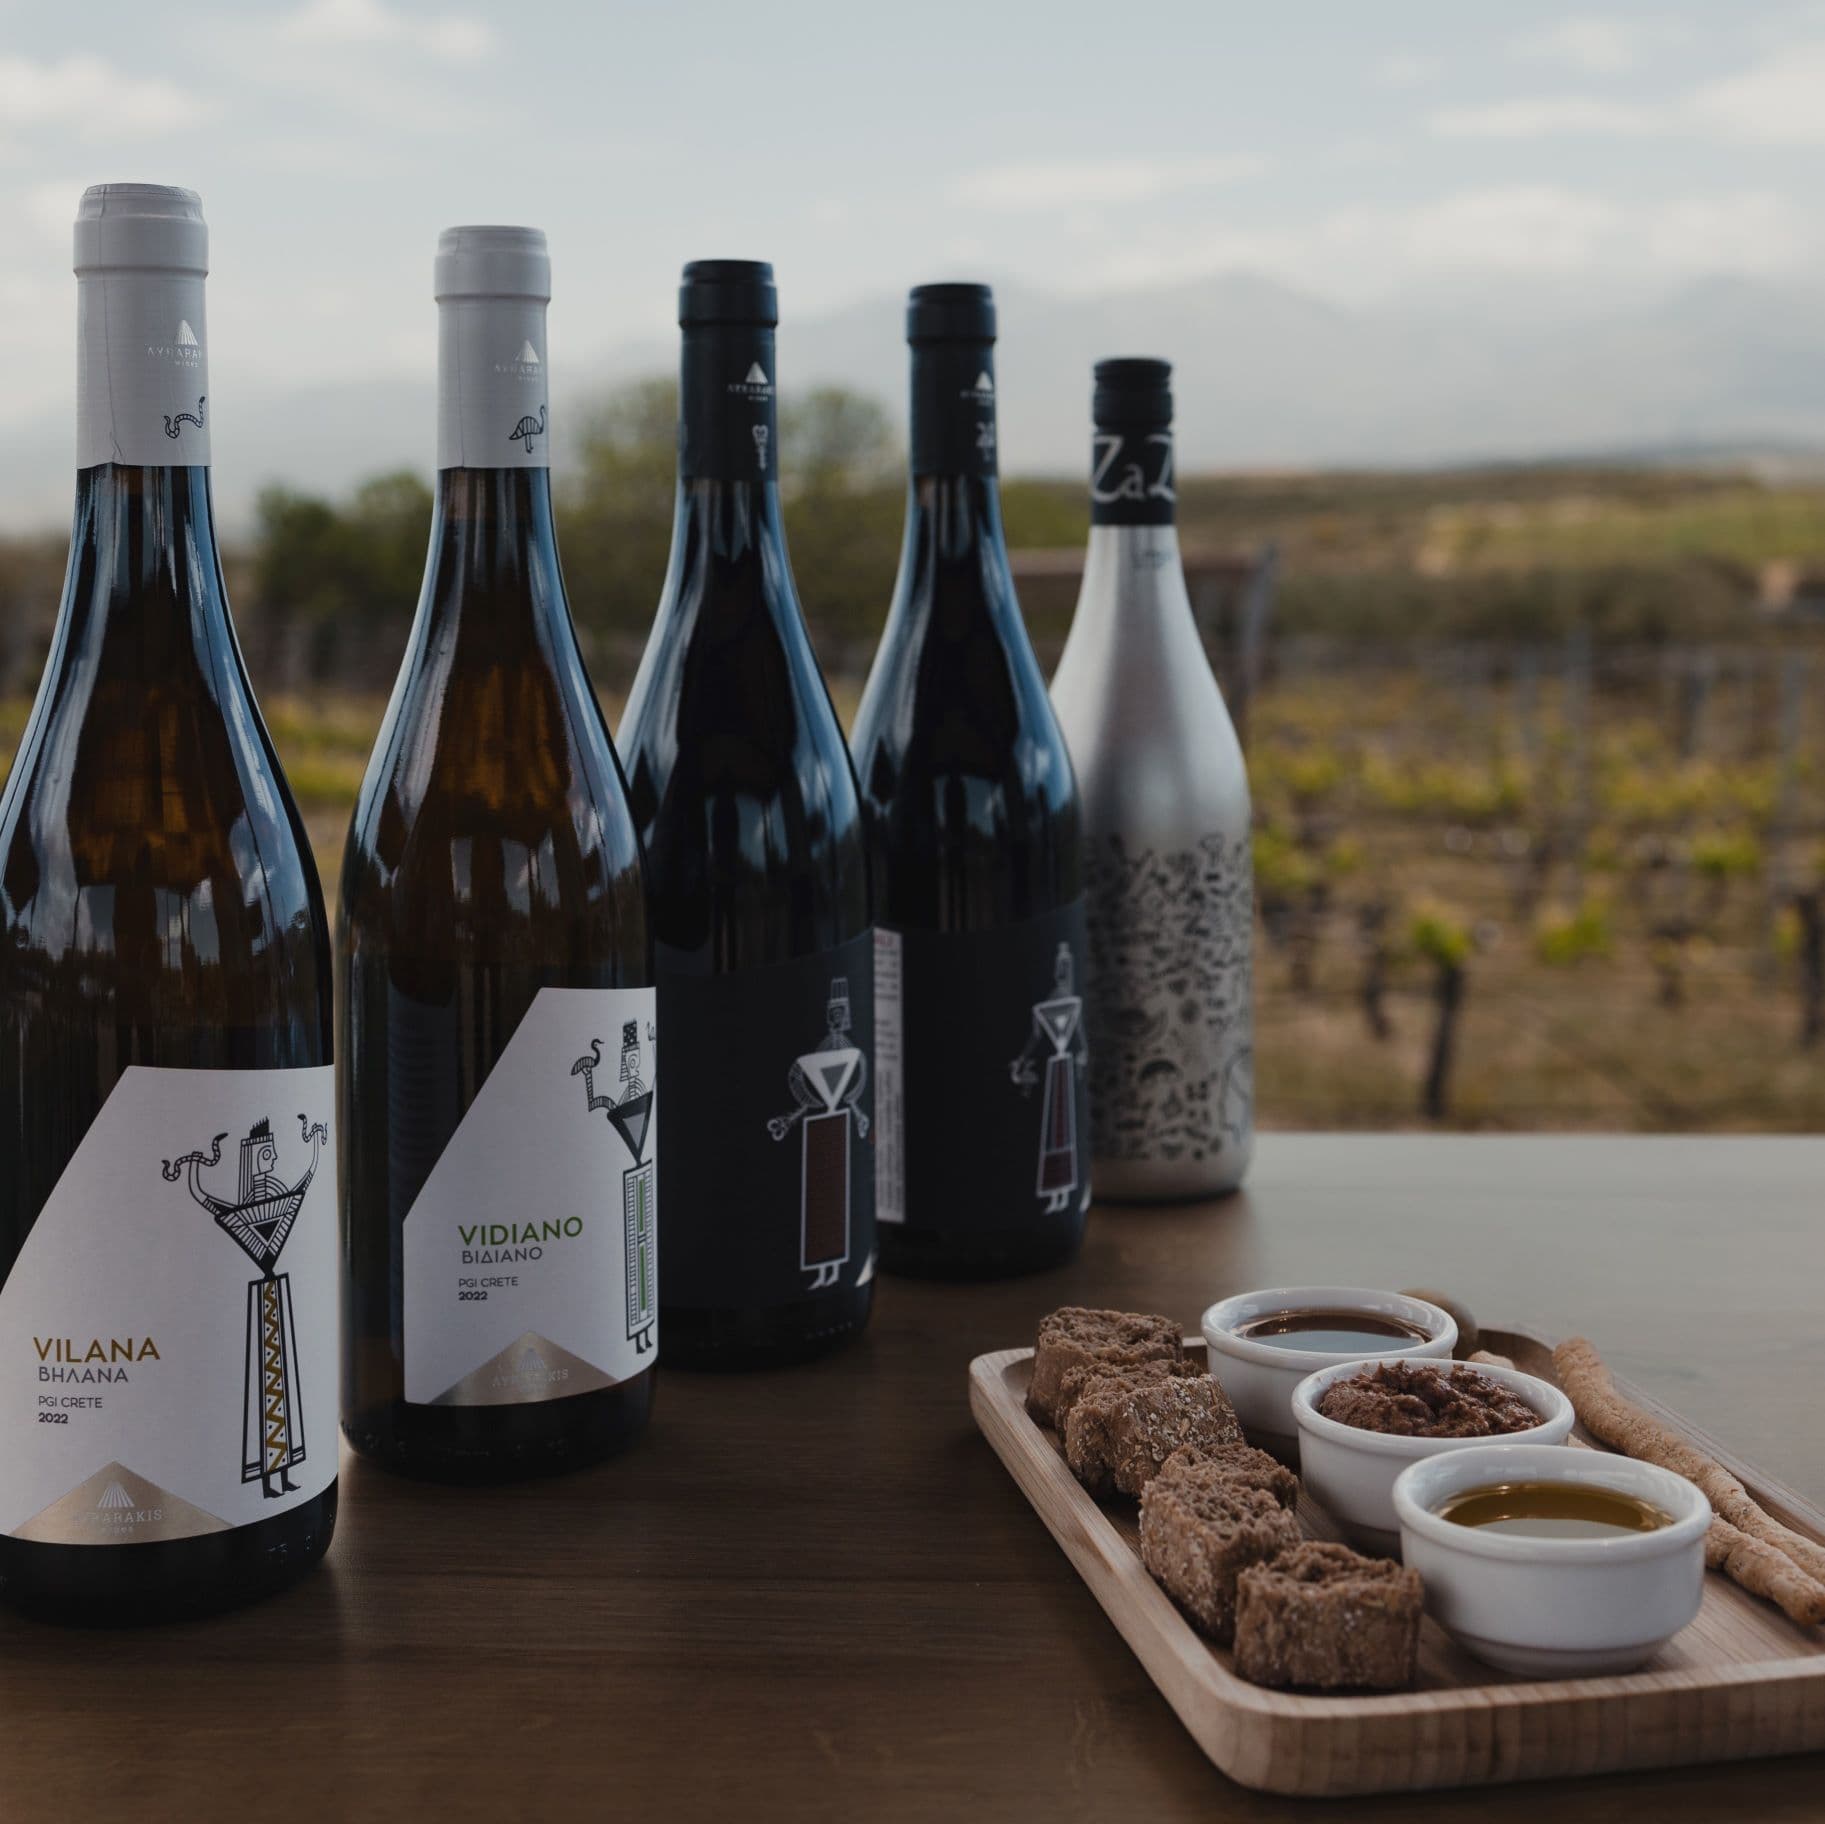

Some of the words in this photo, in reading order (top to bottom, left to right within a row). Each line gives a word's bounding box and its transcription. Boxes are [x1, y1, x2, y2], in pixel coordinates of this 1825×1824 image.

[458, 1216, 583, 1246] VIDIANO
[462, 1246, 543, 1264] ΒΙΔΙΑΝΟ
[458, 1278, 478, 1288] PGI
[480, 1276, 519, 1287] CRETE
[458, 1291, 488, 1301] 2022
[33, 1336, 160, 1362] VILANA
[39, 1366, 128, 1383] ΒΗΛΑΝΑ
[38, 1396, 57, 1407] PGI
[61, 1397, 103, 1408] CRETE
[38, 1412, 68, 1424] 2022
